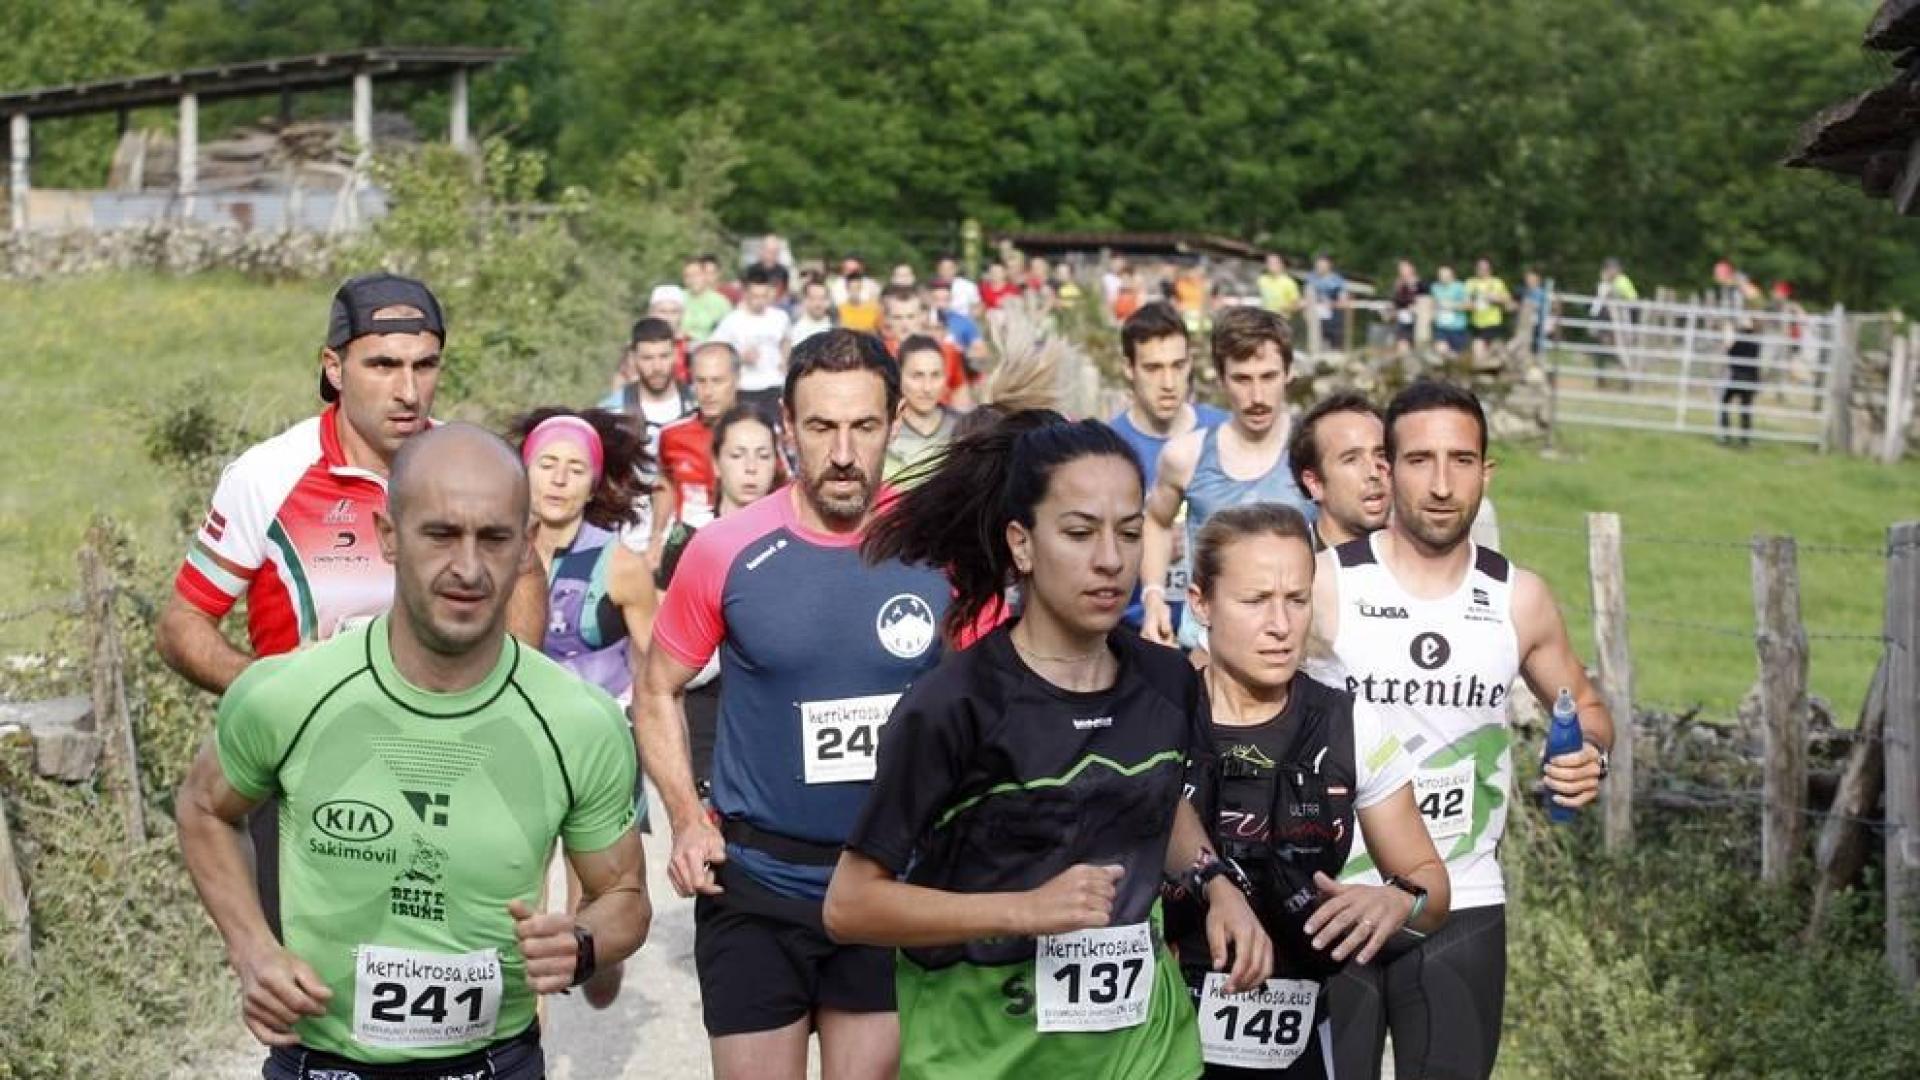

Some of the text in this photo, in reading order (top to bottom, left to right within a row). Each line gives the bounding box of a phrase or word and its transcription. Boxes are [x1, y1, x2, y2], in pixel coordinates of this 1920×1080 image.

[326, 807, 378, 833] KIA
[1419, 788, 1464, 819] 42
[309, 838, 397, 864] Sakimóvil
[1053, 958, 1144, 1004] 137
[371, 982, 484, 1024] 241
[1213, 1005, 1302, 1045] 148
